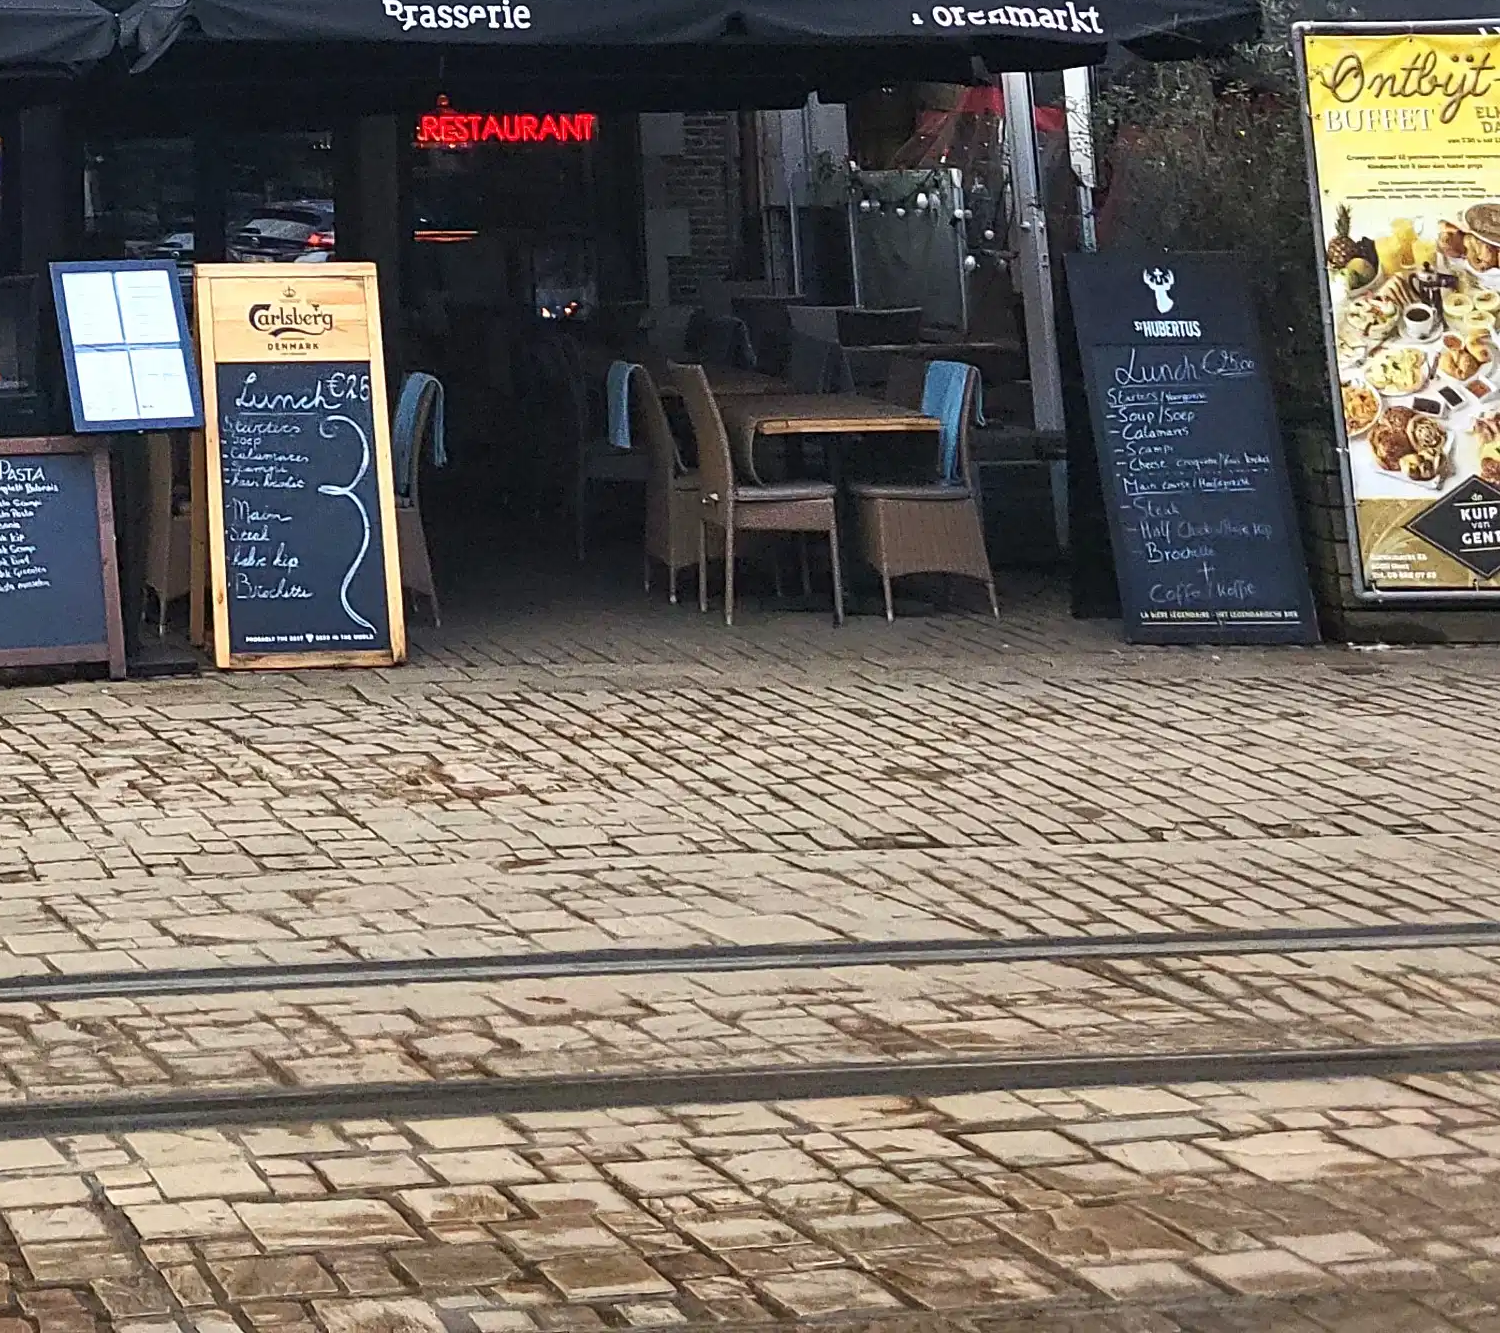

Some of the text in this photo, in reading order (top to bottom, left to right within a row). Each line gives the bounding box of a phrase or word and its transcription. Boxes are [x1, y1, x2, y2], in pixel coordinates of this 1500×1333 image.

[417, 113, 596, 143] RESTAURANT
[1326, 107, 1435, 133] BUFFET
[248, 304, 334, 337] Carlsberg
[1144, 320, 1202, 338] HUBERTUS
[267, 342, 320, 351] DENMARK
[1115, 348, 1200, 385] Lunch
[235, 371, 342, 410] Lunch
[1460, 507, 1498, 521] KUIP
[1471, 520, 1491, 529] van
